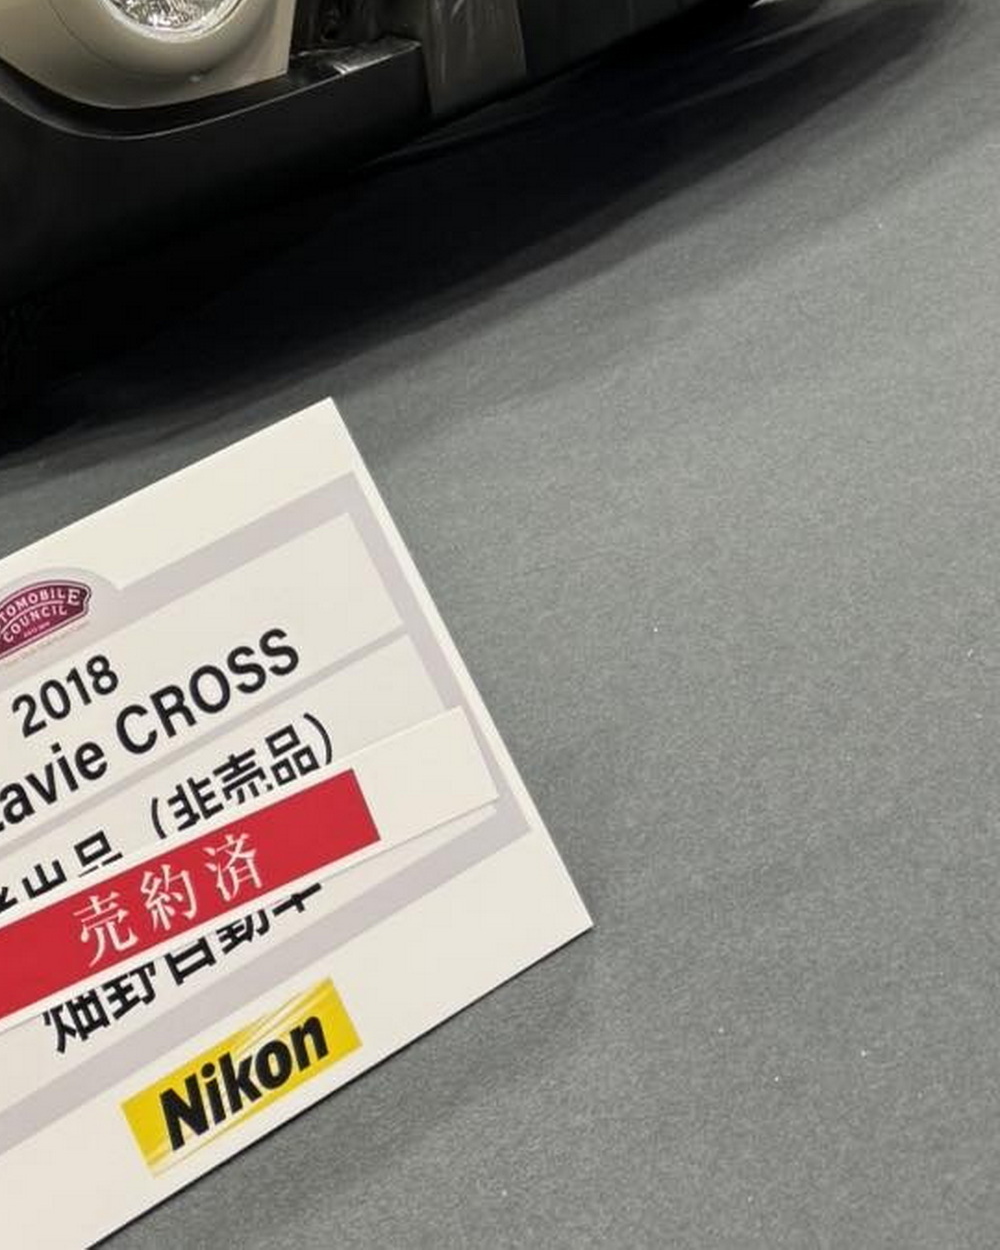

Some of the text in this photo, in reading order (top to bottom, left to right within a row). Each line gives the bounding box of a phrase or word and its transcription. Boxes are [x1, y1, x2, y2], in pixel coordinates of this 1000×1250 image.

[3, 605, 68, 642] COUNCIL
[12, 655, 119, 738] 2018
[116, 628, 300, 755] CROSS
[72, 833, 264, 968] 売約済
[160, 1015, 329, 1151] Nikon
